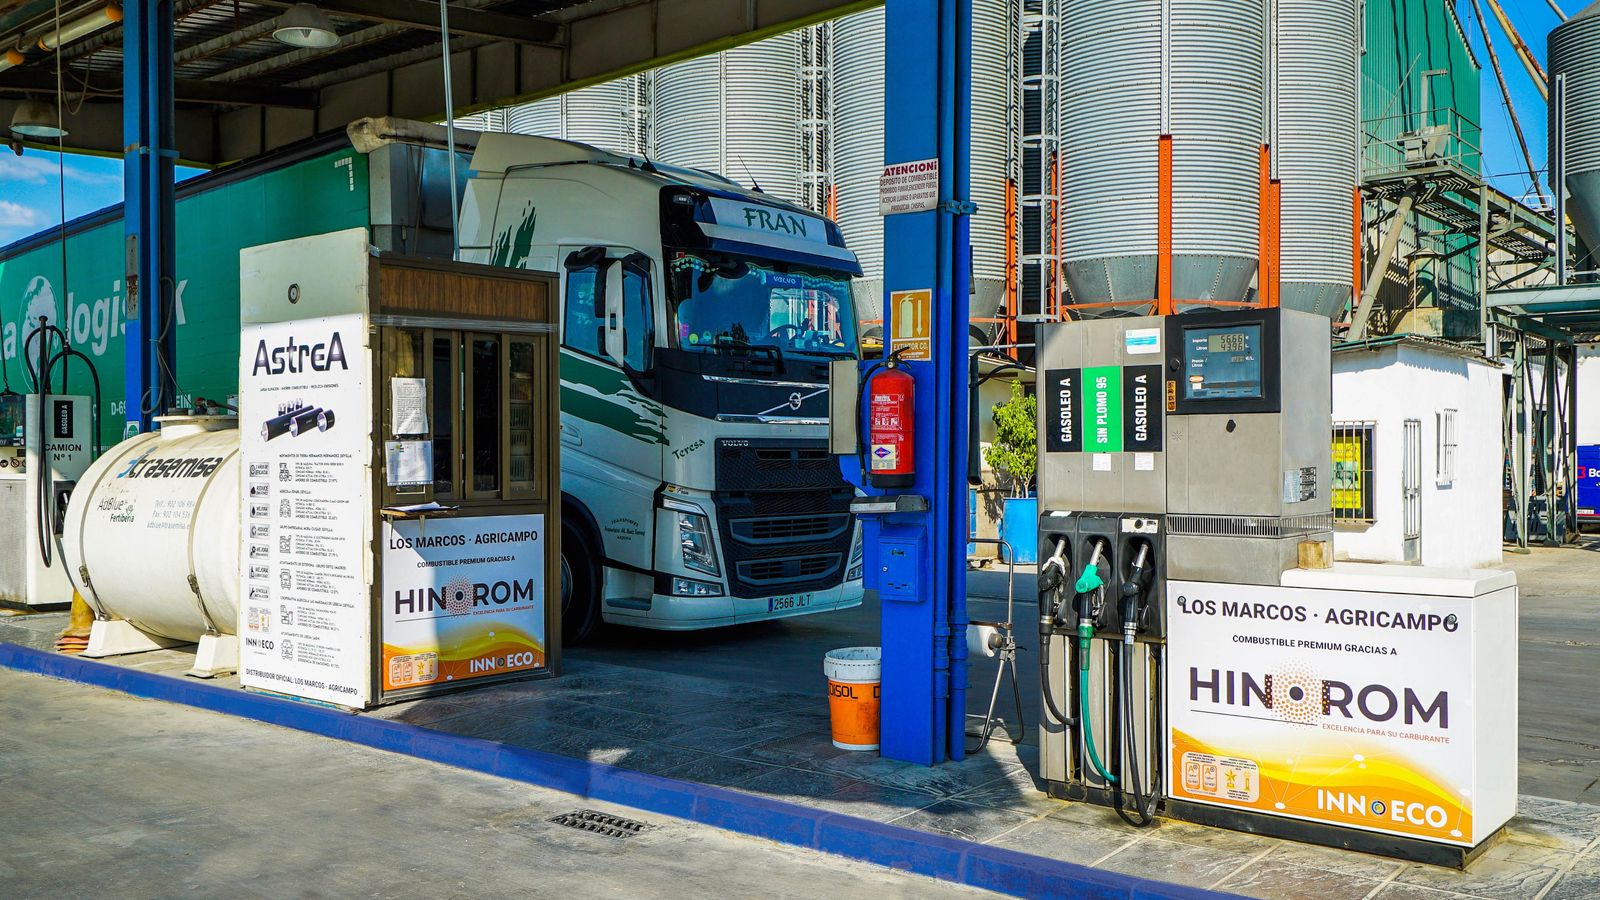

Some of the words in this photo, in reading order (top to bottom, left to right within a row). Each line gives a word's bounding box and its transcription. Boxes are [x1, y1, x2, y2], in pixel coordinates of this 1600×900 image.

[880, 176, 901, 186] DEPOSITO
[901, 176, 908, 184] DE
[908, 172, 938, 182] COMBUSTIBLE
[742, 206, 807, 238] FRAN
[773, 274, 796, 285] VOLVO
[1060, 378, 1071, 387] A
[1096, 376, 1108, 389] 95
[1134, 374, 1147, 384] A
[1060, 390, 1072, 442] GASOLEO
[1096, 391, 1108, 425] PLOMO
[1134, 386, 1148, 442] GASOLEO
[721, 440, 750, 448] VOLVO
[1096, 427, 1108, 444] SIN
[45, 444, 82, 452] CAMION
[671, 438, 706, 460] Teresa
[68, 454, 72, 462] 1
[390, 538, 412, 550] LOS
[416, 534, 466, 548] MARCOS
[474, 530, 538, 544] AGRICAMPO
[417, 560, 458, 568] COMBUSTIBLE
[774, 598, 794, 610] 2566
[796, 594, 811, 608] JLT
[1182, 600, 1216, 616] LOS
[1222, 601, 1307, 622] MARCOS
[1324, 607, 1459, 633] AGRICAMPO
[1232, 634, 1296, 648] COMBUSTIBLE
[1298, 640, 1342, 652] PREMIUM
[1344, 644, 1386, 656] GRACIAS
[1390, 647, 1398, 656] A
[246, 668, 276, 681] DISTRIBUIDOR
[276, 674, 294, 684] OFICIAL:
[294, 678, 304, 686] LOS
[304, 679, 326, 690] MARCOS
[328, 684, 358, 696] AGRICAMPO
[1322, 723, 1366, 735] EXCELENCIA
[1366, 728, 1386, 737] PARA
[1399, 732, 1450, 744] CARBURANTE
